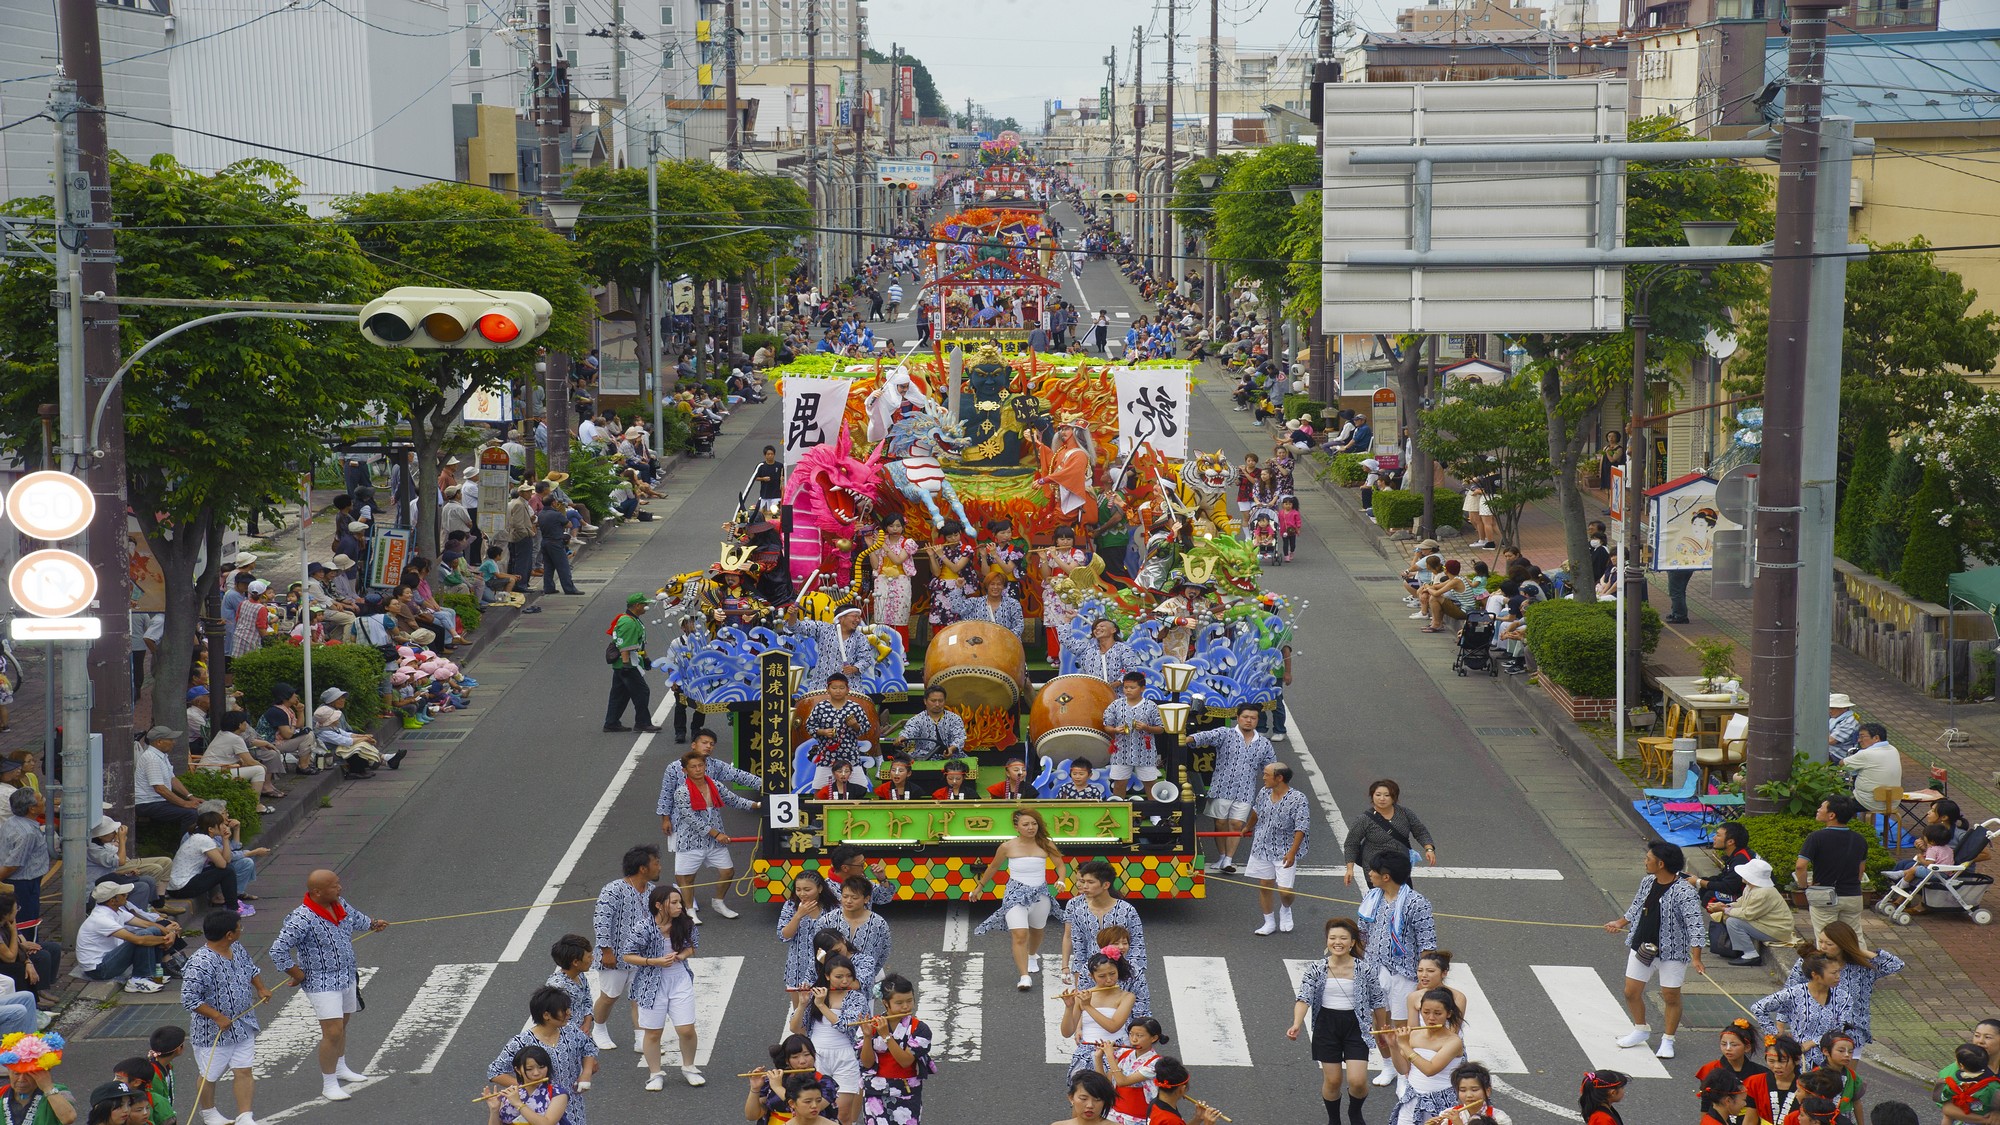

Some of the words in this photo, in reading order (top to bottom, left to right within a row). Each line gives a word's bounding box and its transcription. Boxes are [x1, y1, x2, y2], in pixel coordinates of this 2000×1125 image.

[29, 492, 73, 519] 50
[777, 801, 793, 823] 3
[841, 808, 1121, 841] わかば四内会
